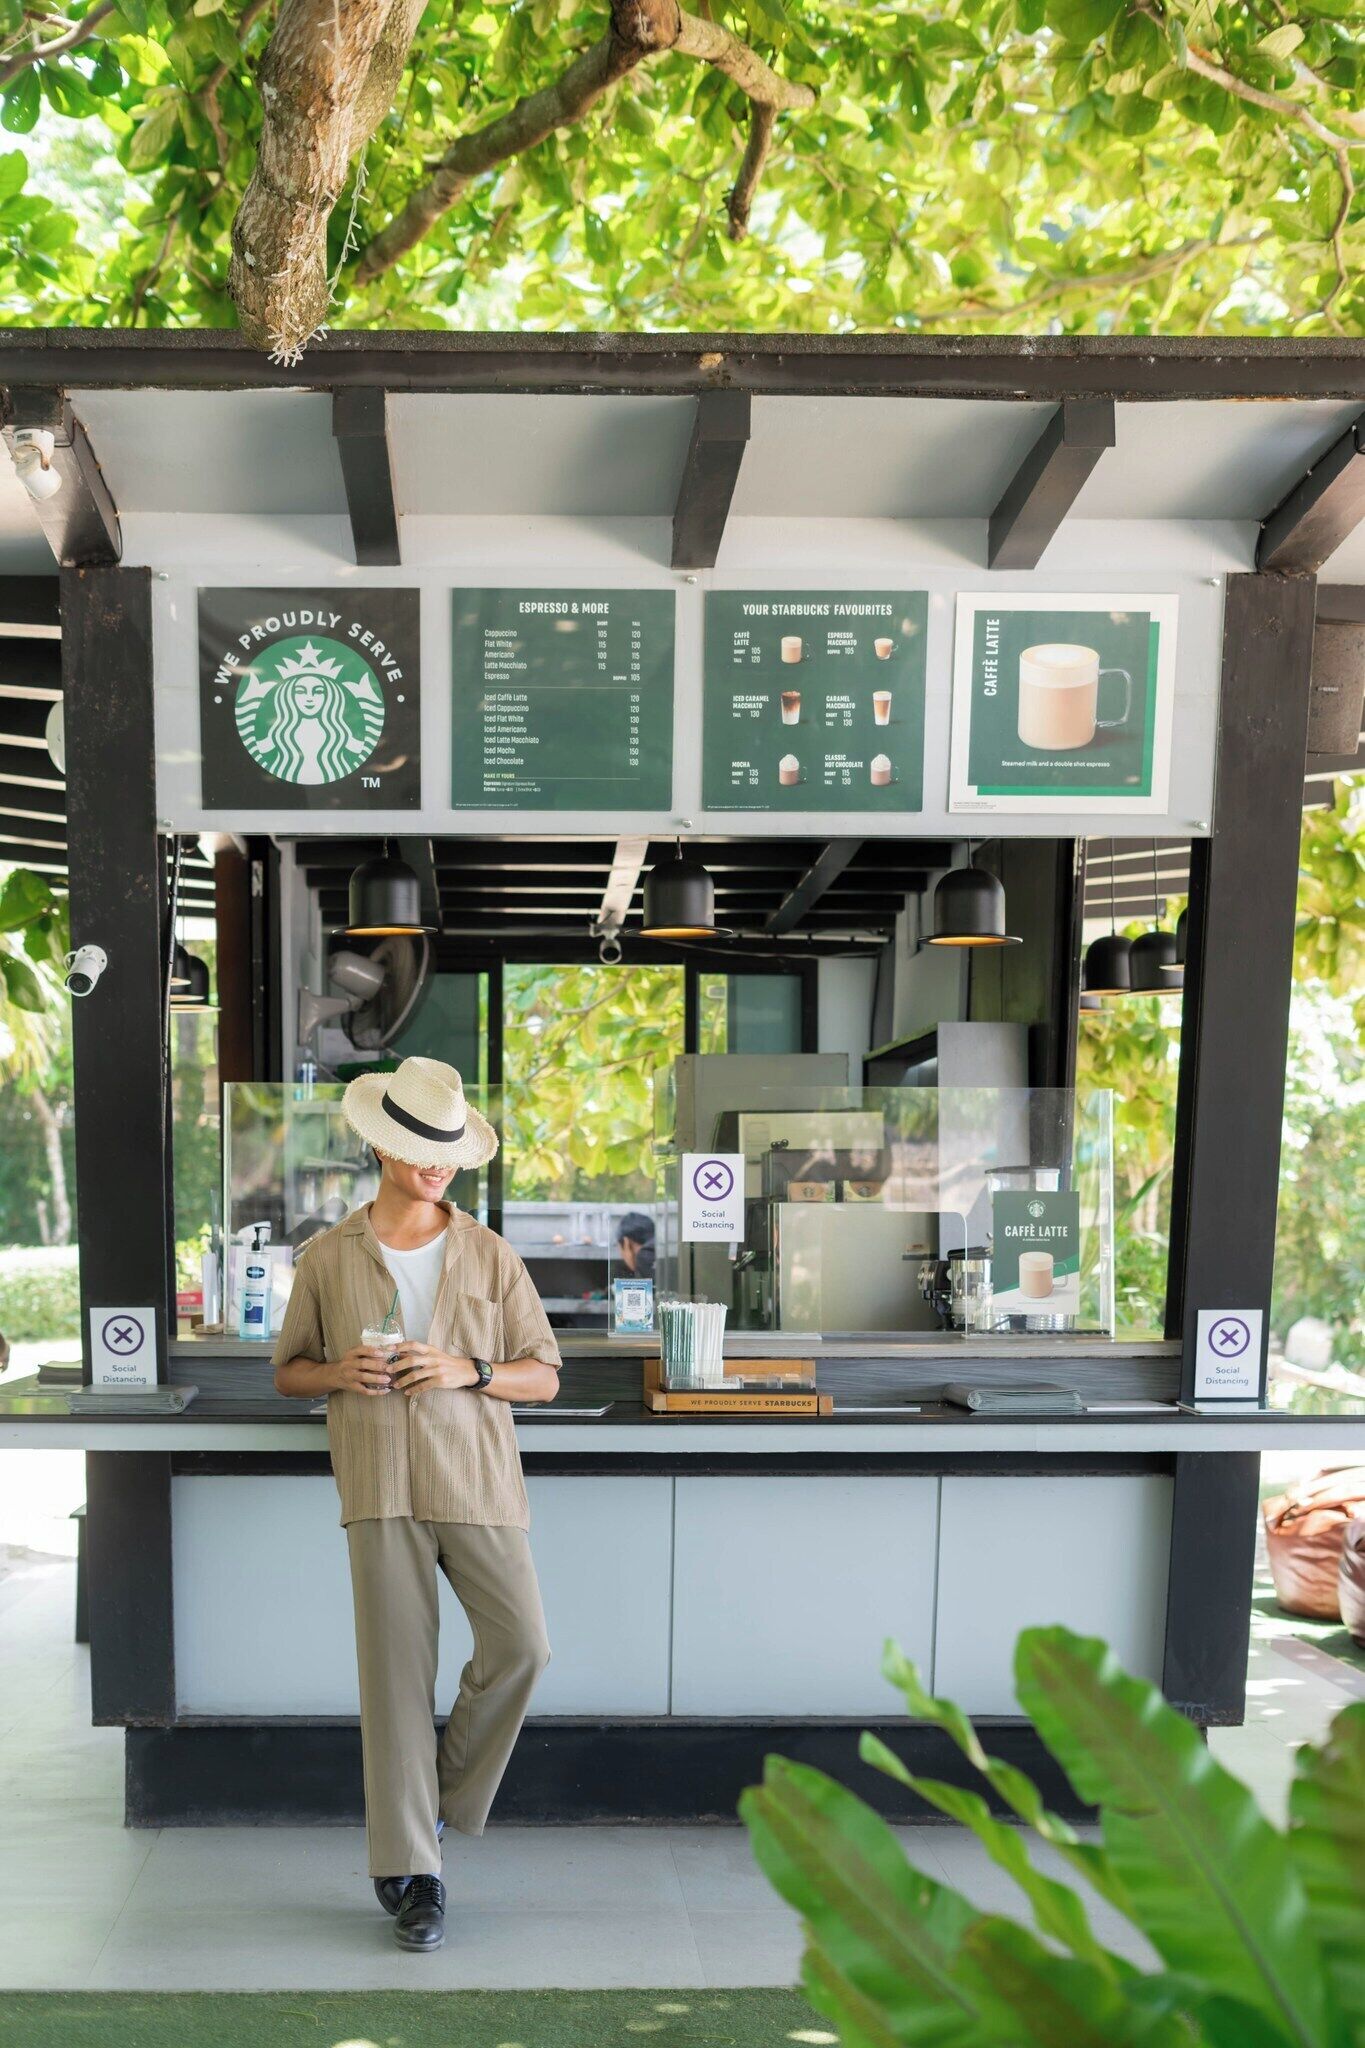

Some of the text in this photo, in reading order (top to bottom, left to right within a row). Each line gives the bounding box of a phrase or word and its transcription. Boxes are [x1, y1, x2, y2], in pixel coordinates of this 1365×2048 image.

[519, 602, 609, 614] ESPRESSO & MORE
[743, 604, 769, 615] YOUR
[834, 605, 892, 615] FAVOURITES
[485, 629, 517, 638] Cappuccino
[214, 610, 403, 684] WE PROUDLY SERVE
[982, 618, 1000, 696] CAFFÈ LATTE
[361, 777, 380, 788] TM
[692, 1221, 734, 1230] Distancing
[1004, 1224, 1068, 1237] CAFFÈ LATTE
[103, 1375, 147, 1384] Distancing
[1206, 1377, 1249, 1386] Distancing
